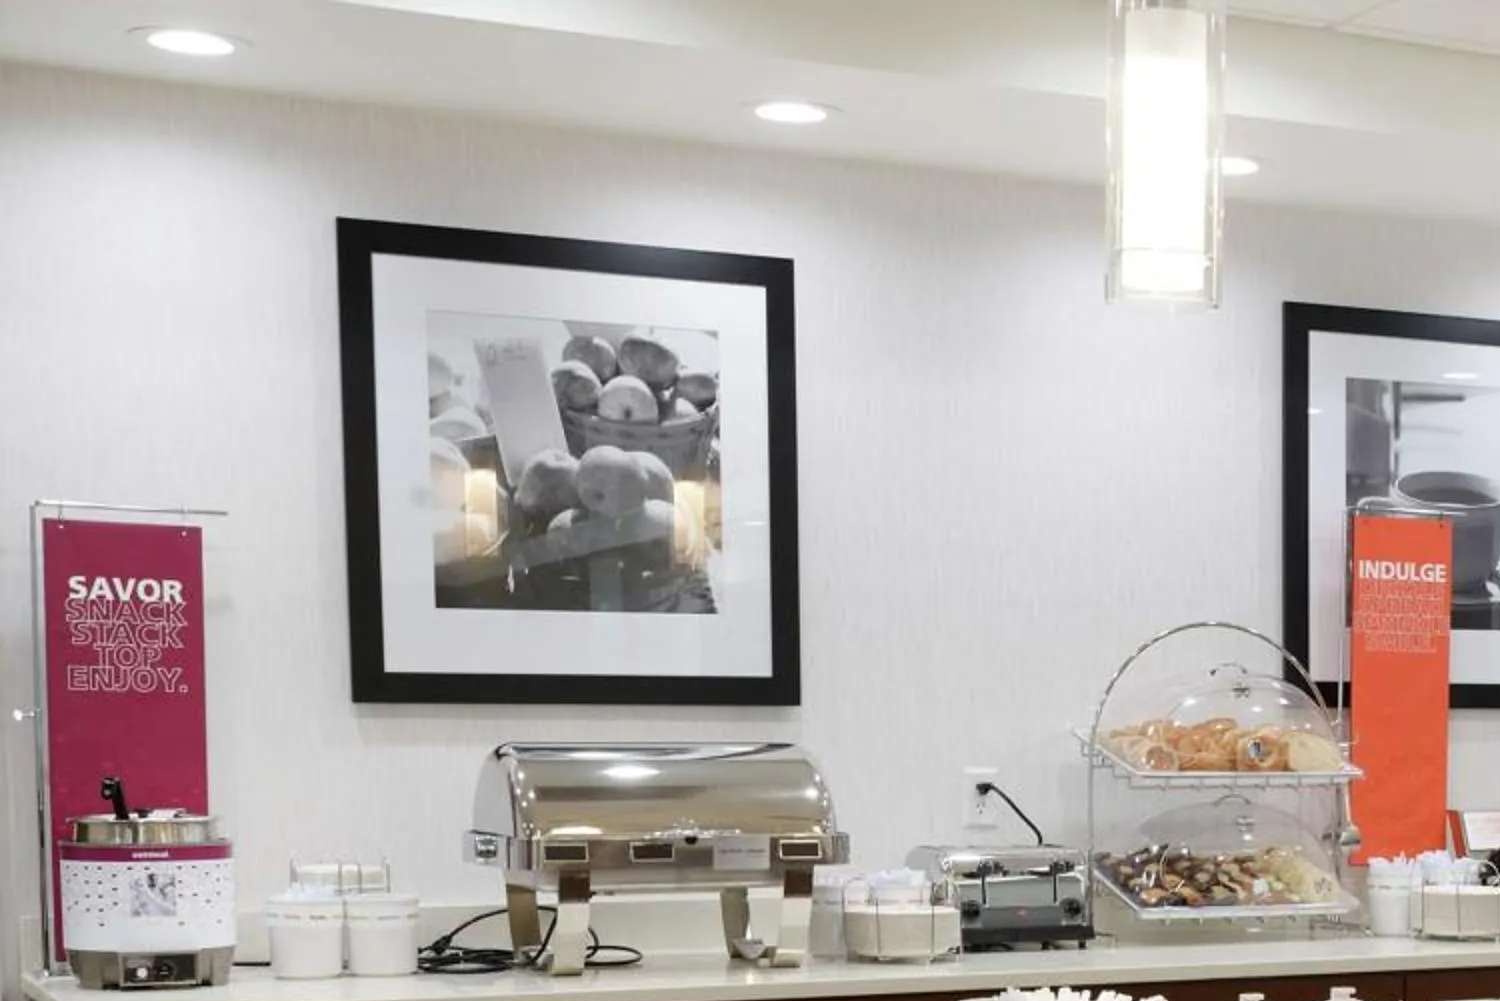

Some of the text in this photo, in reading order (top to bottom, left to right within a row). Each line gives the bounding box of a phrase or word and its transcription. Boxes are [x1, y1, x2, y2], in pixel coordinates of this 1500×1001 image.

[1359, 559, 1447, 582] INDULGE
[67, 575, 183, 602] SAVOR
[64, 598, 188, 626] SNACK
[71, 620, 184, 648] STACK
[93, 643, 162, 669] TOP
[67, 664, 188, 693] ENJOY.
